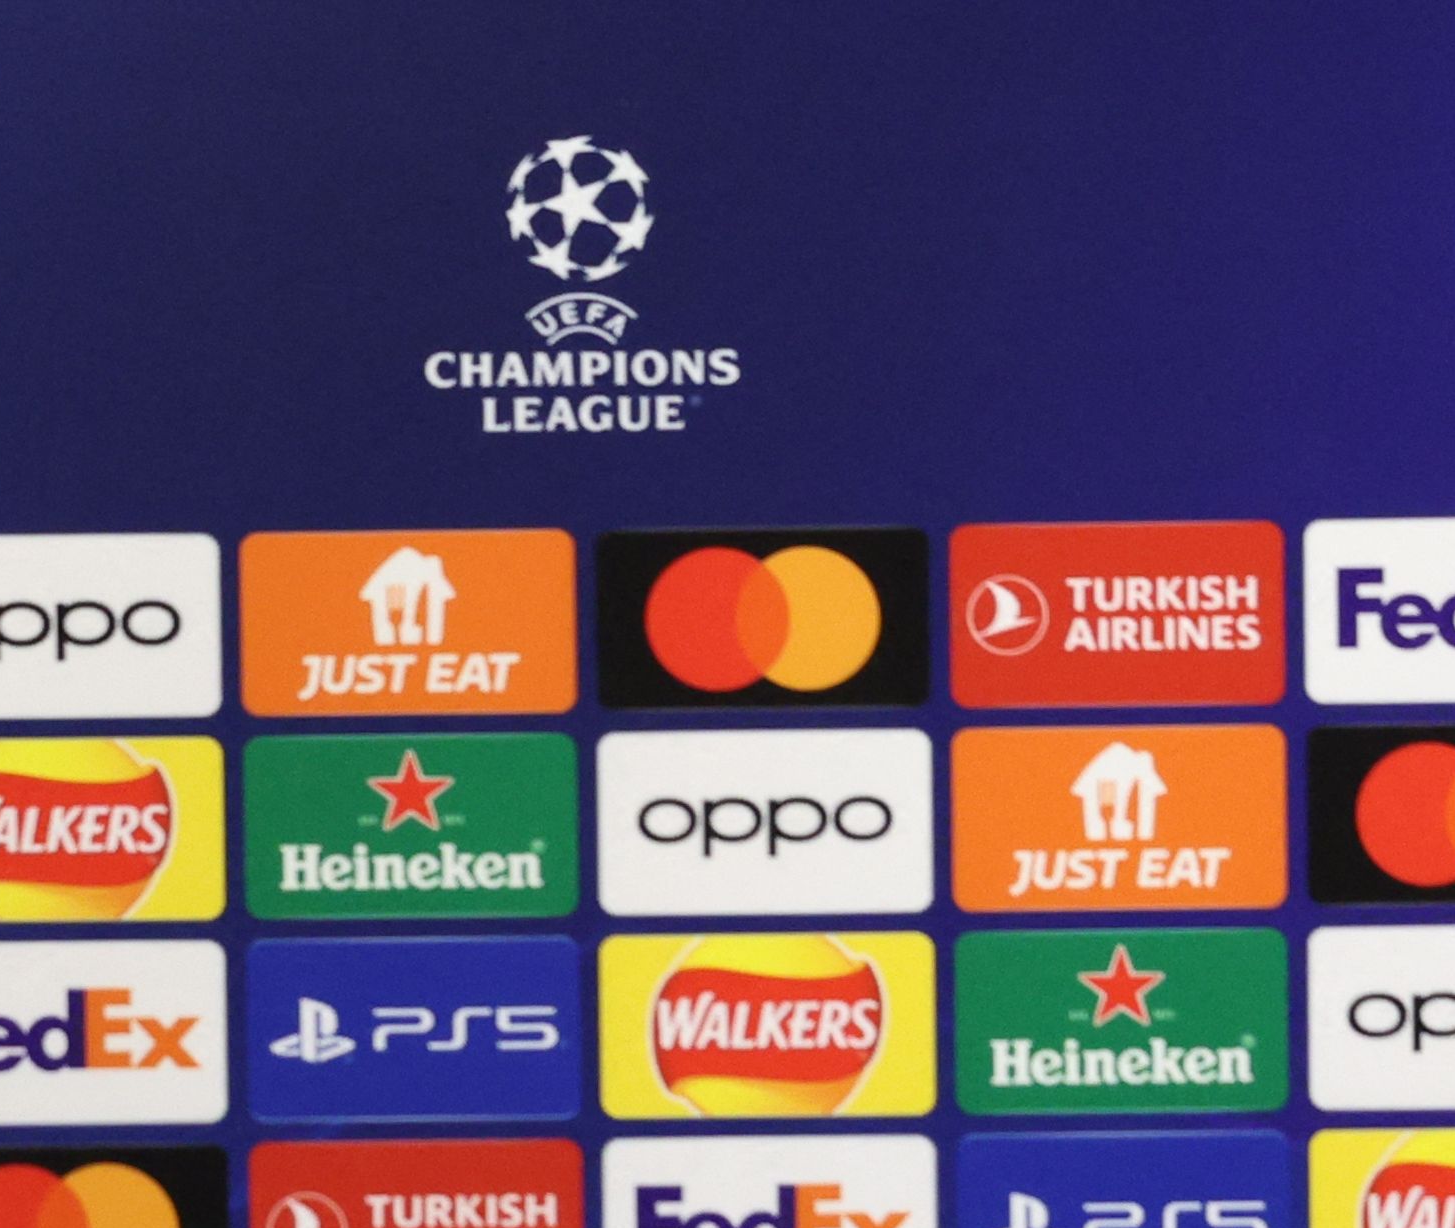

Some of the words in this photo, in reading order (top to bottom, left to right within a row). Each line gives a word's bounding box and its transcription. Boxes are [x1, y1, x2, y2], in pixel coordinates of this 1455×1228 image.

[529, 302, 629, 337] UEFA
[424, 348, 740, 389] CHAMPIONS
[482, 395, 685, 433] LEAGUE
[1065, 575, 1259, 612] TURKISH
[1064, 614, 1262, 651] AIRLINES
[298, 653, 417, 701] JUST
[426, 652, 521, 693] EAT
[637, 795, 893, 858] oppo
[280, 842, 544, 891] Heineken
[1008, 848, 1128, 897] JUST
[1136, 847, 1231, 889] EAT
[372, 1005, 559, 1052] PS5
[655, 984, 883, 1056] WALKERS
[990, 1037, 1254, 1087] Heineken
